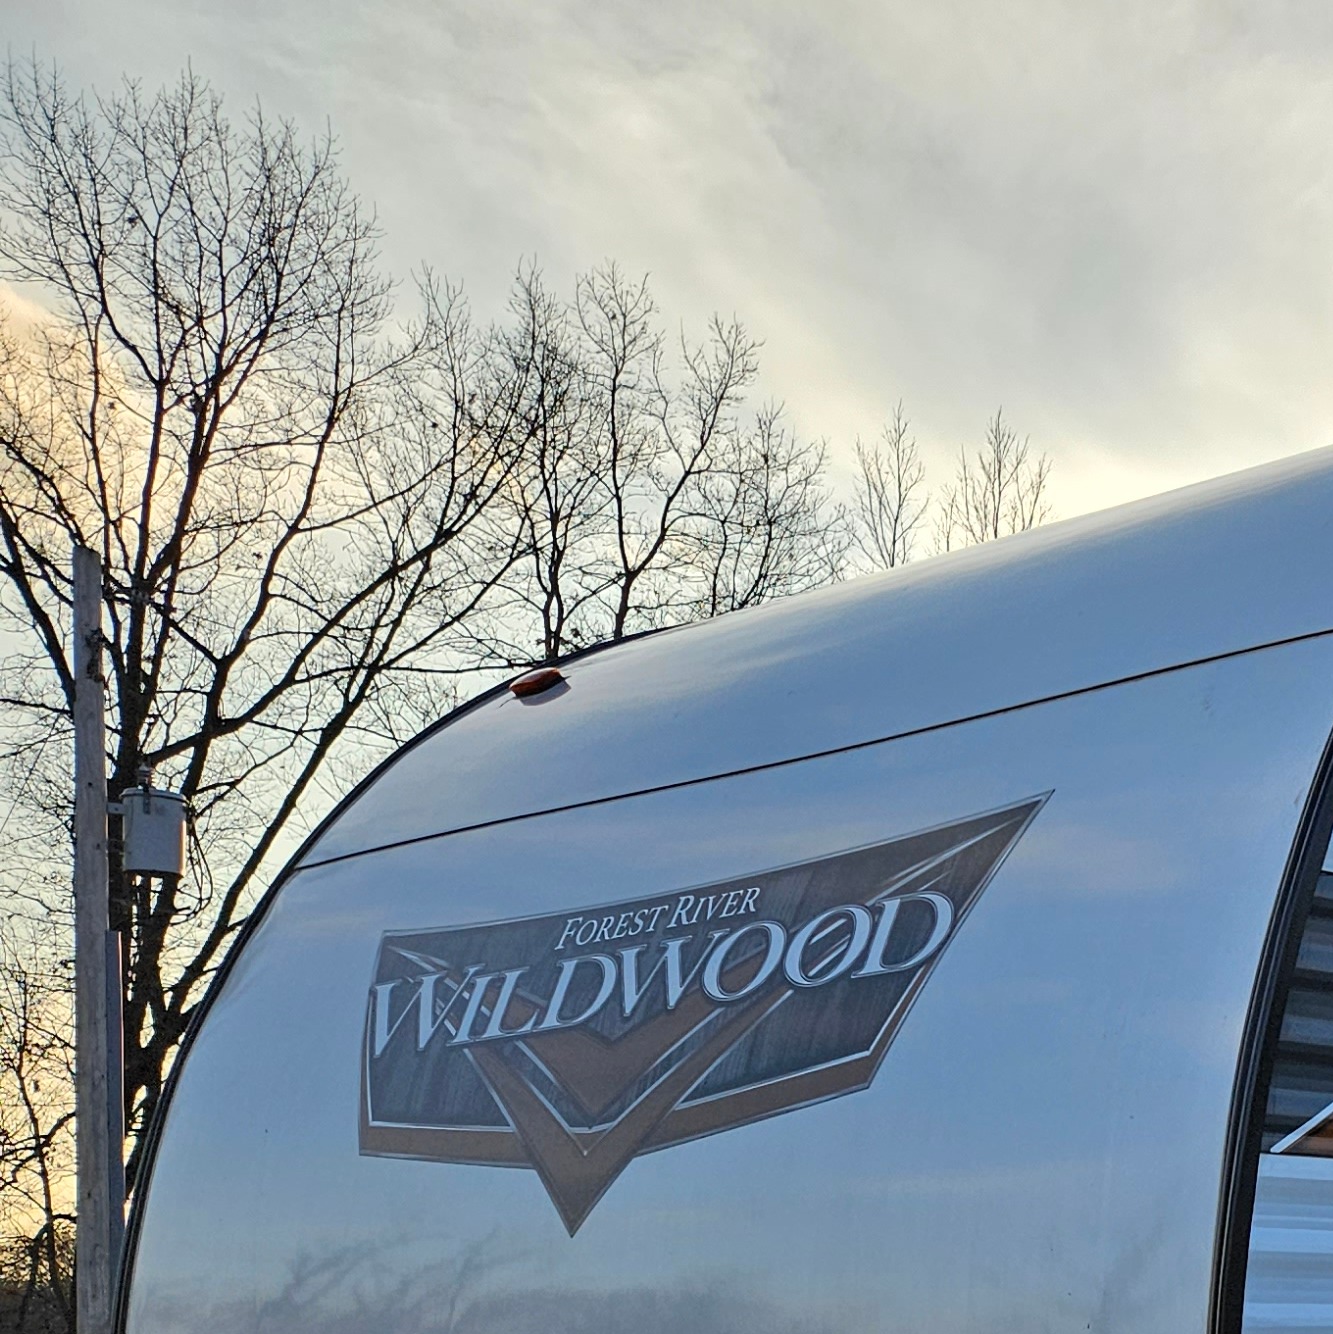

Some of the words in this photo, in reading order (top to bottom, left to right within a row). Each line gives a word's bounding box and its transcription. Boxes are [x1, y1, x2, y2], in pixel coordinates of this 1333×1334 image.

[371, 891, 955, 1060] WILDWOOD
[554, 904, 669, 951] FOREST
[667, 886, 761, 928] RIVER
